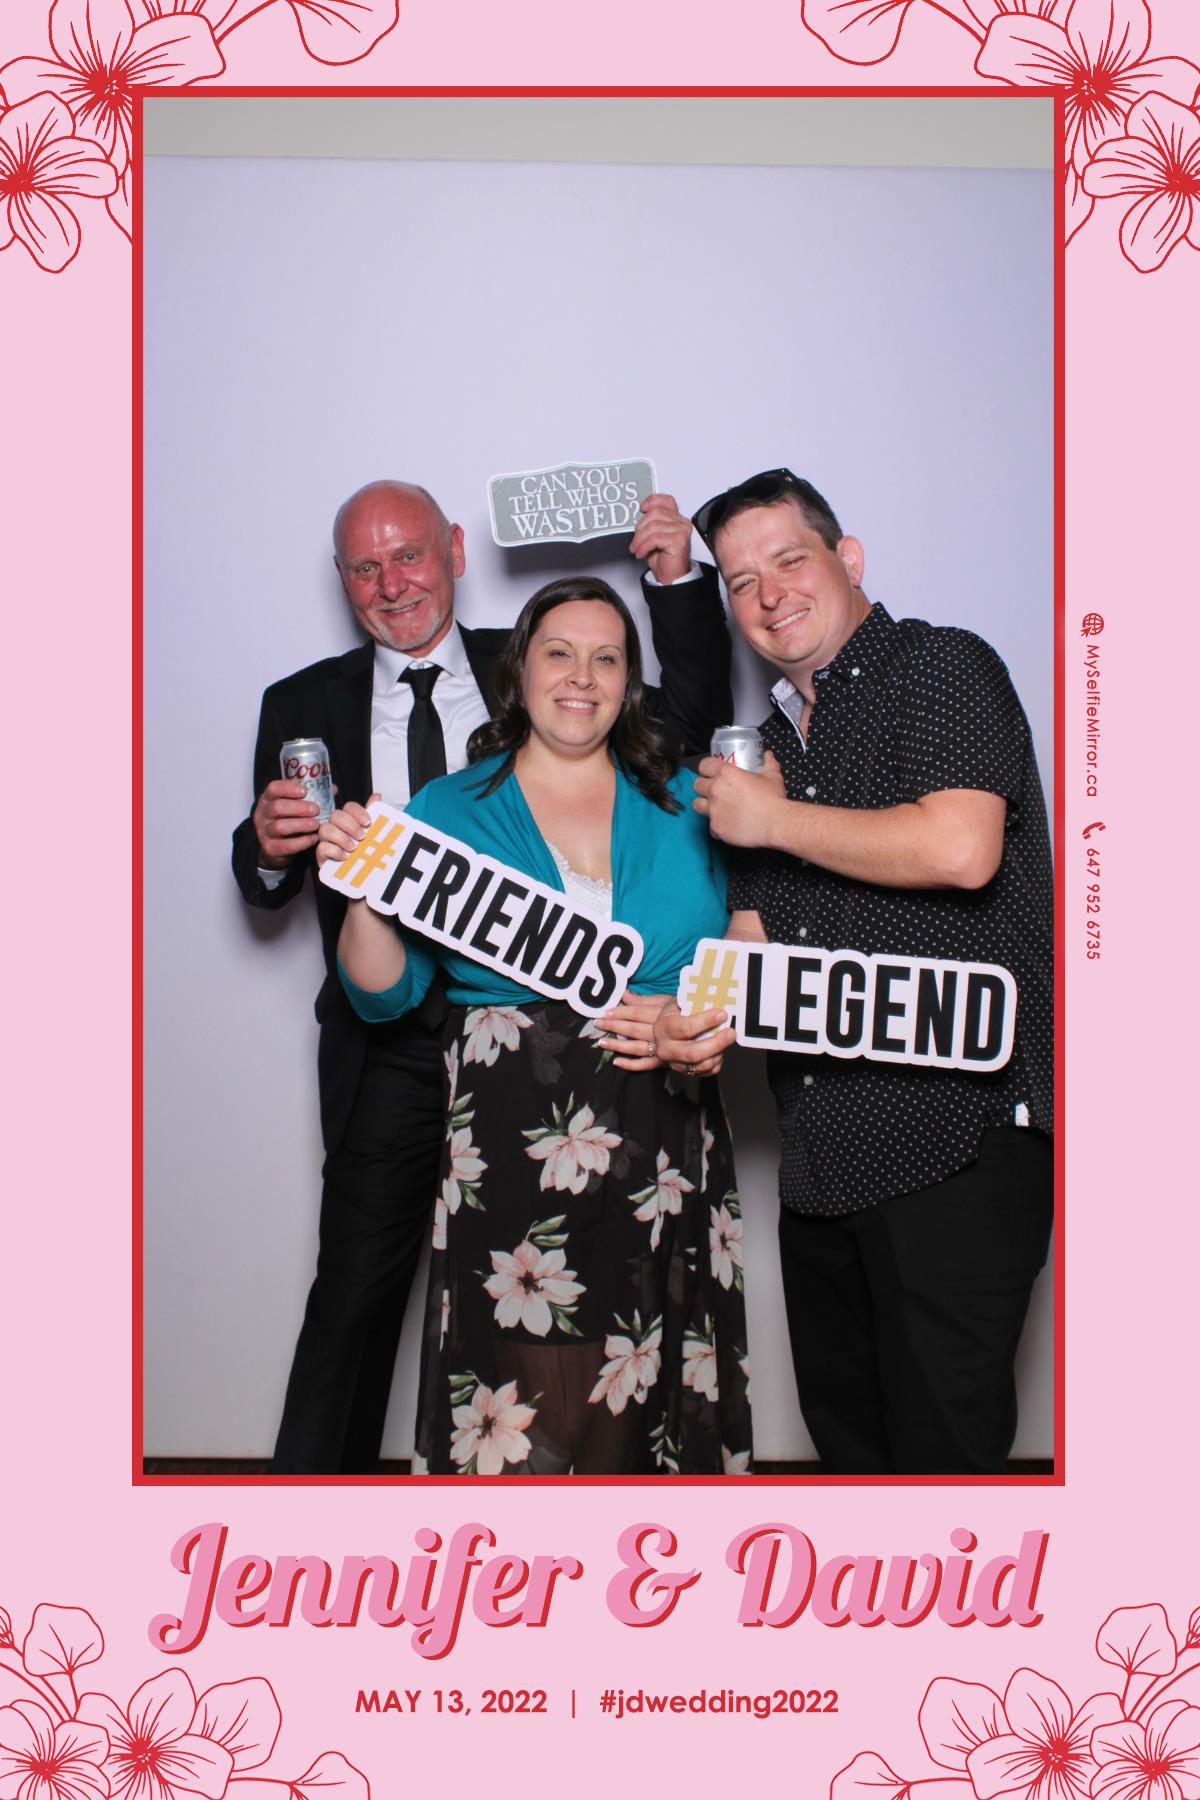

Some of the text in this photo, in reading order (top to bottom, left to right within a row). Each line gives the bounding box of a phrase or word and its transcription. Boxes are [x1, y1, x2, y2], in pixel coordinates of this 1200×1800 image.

[521, 466, 620, 495] CAN YOU
[509, 482, 638, 514] TELL WHO'S
[511, 501, 640, 538] WASTED?
[284, 757, 332, 780] Coor
[334, 815, 634, 1009] #FRIENDS
[686, 949, 1006, 1061] #LEGEND
